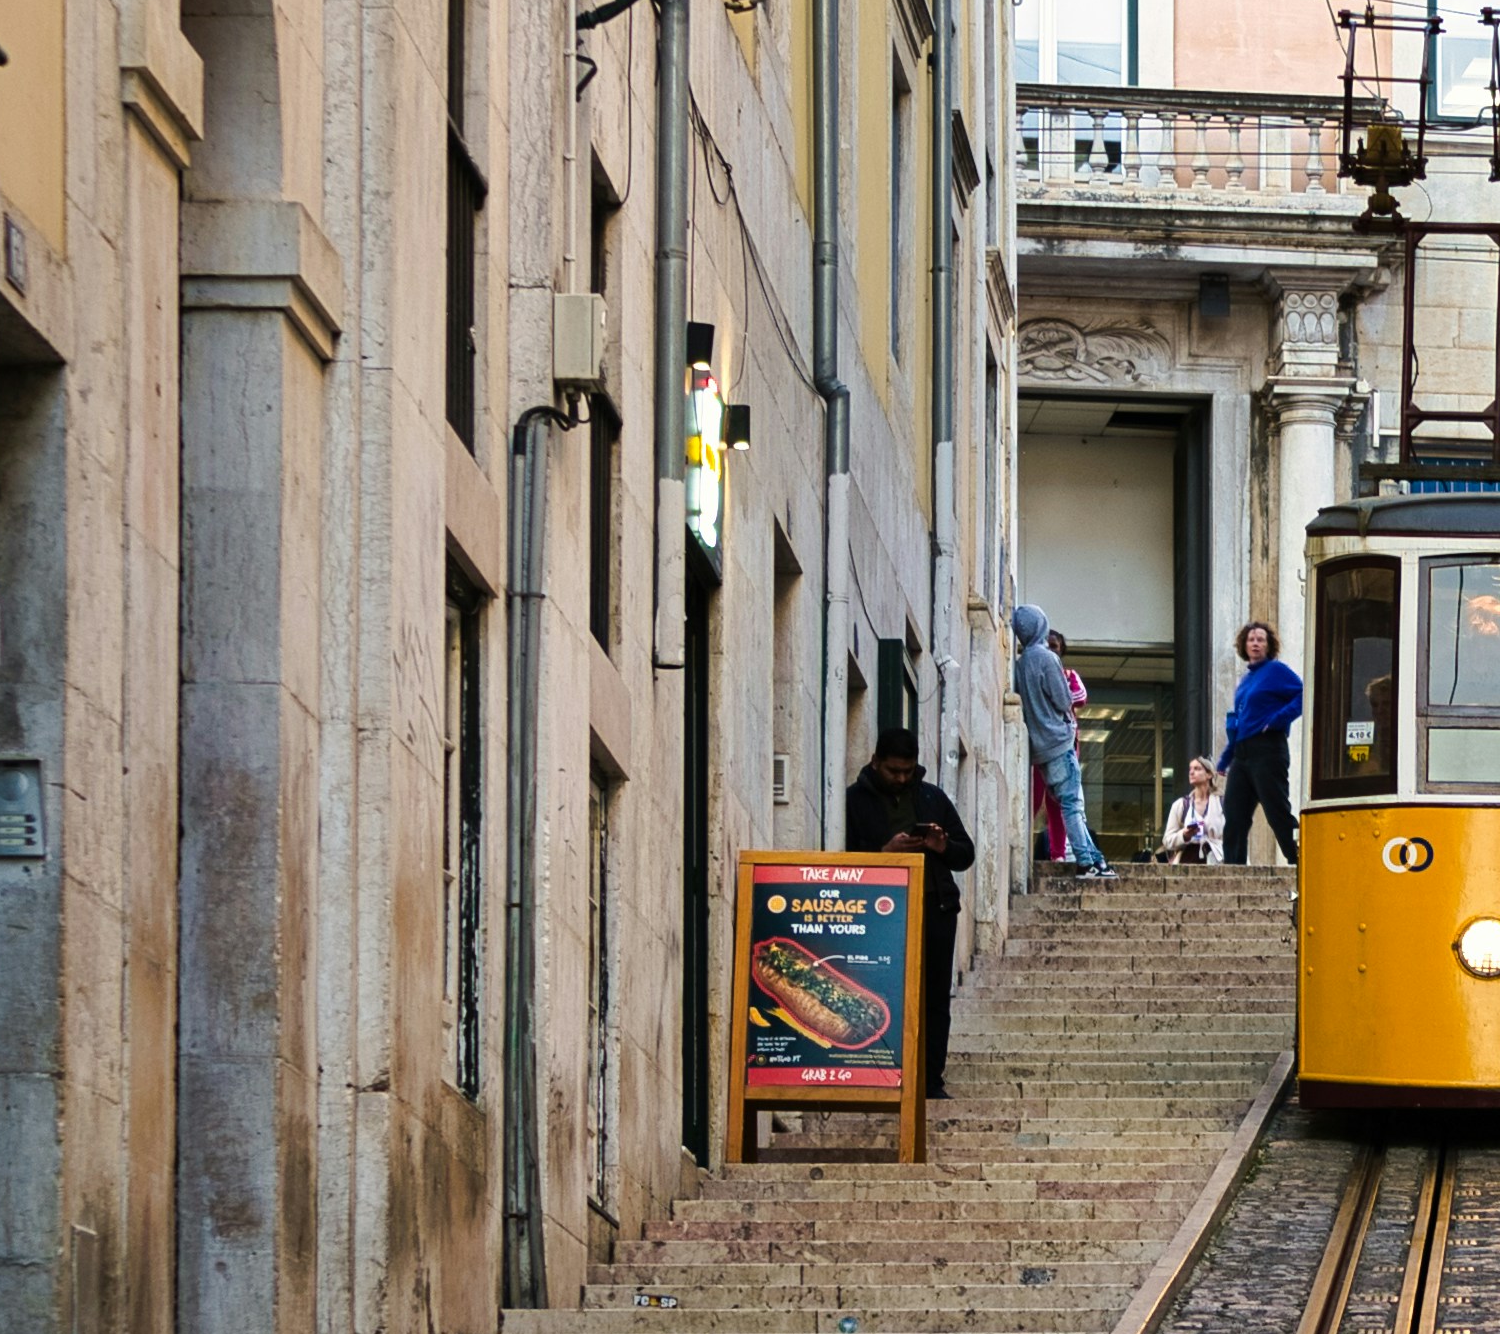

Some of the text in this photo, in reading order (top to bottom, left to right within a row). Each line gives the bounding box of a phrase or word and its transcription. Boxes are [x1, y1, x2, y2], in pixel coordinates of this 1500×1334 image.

[800, 867, 865, 883] TAKE AWAY
[819, 889, 840, 899] OUR
[791, 899, 868, 914] SAUSAGE
[804, 914, 854, 924] IS BETTER
[790, 923, 866, 936] THAN YOURS
[801, 1068, 852, 1082] GRAB 2 GO
